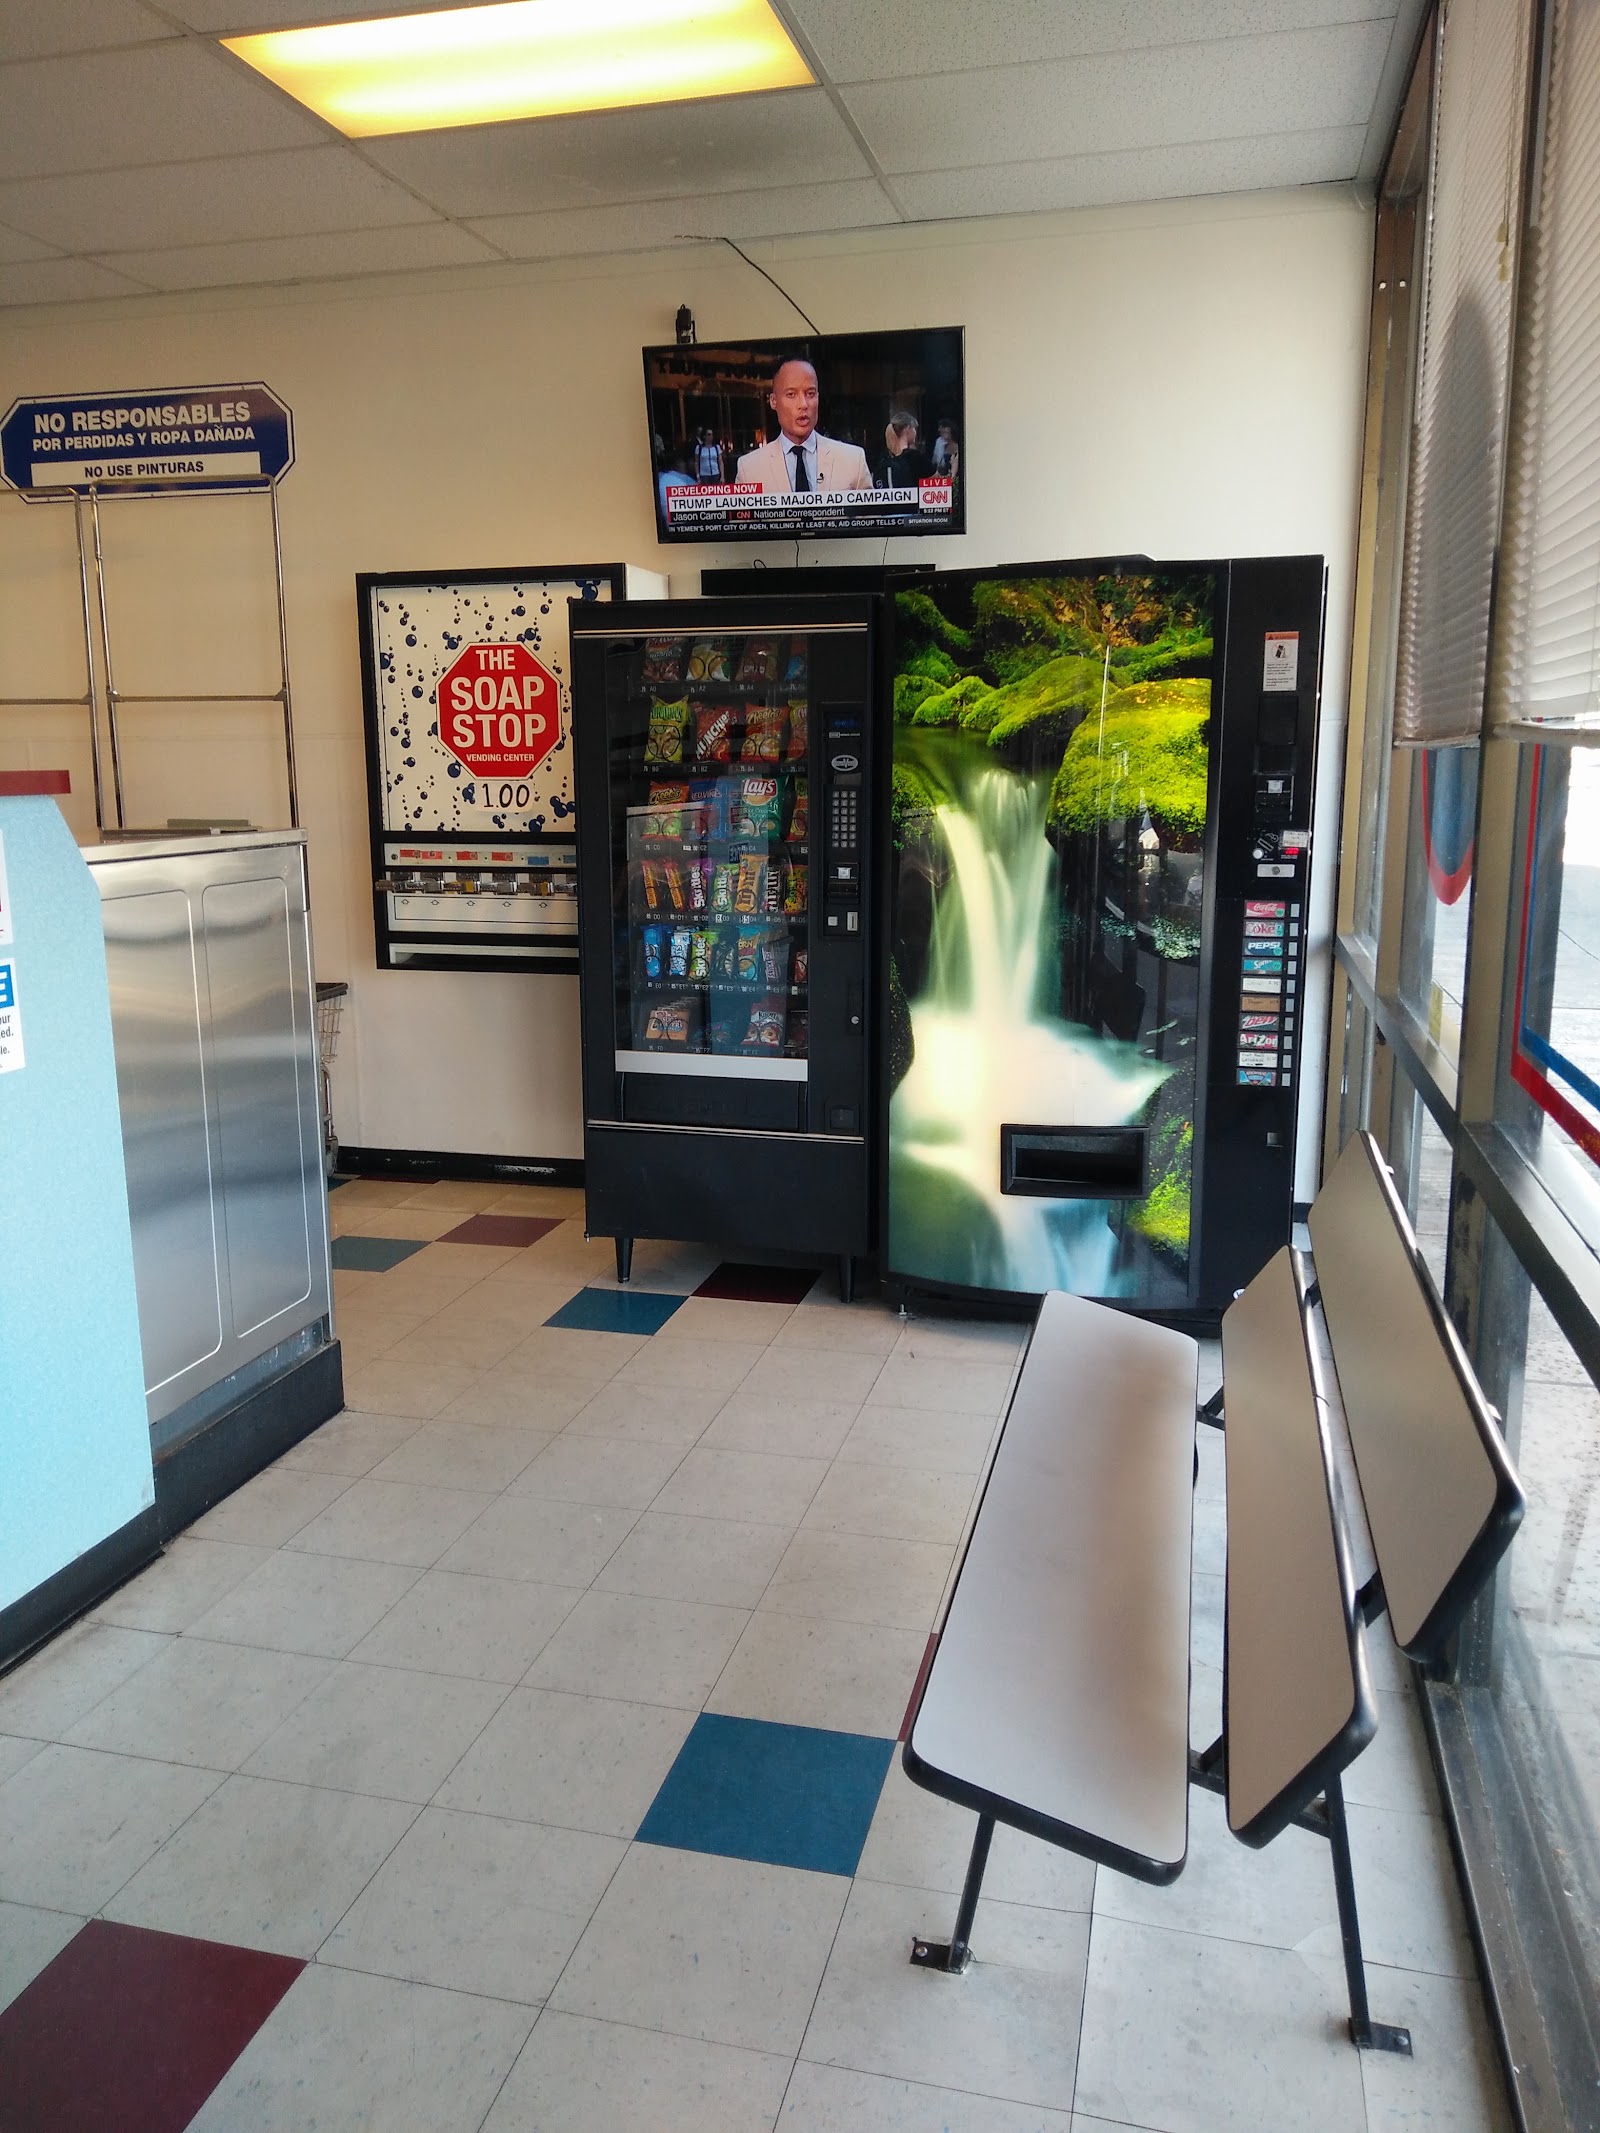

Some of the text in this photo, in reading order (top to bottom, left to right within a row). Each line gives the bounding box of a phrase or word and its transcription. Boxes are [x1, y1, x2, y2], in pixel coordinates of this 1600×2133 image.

[34, 402, 250, 433] NO RESPONSABLES
[32, 424, 255, 451] POR PERDIDAS Y ROPA DAÑADA
[84, 461, 204, 477] NO USE PINTURAS
[671, 484, 758, 496] DEVELOPING NOW
[923, 479, 948, 487] LIVE
[672, 491, 912, 510] TRUMP LAUNCHES MAJOR AD CAMPAIGN
[922, 490, 948, 504] CNN
[673, 507, 845, 522] Jason Carroll CNN National Correspondent
[676, 525, 704, 533] YEMEN'S
[705, 524, 722, 532] PORT
[749, 523, 769, 531] ADEN,
[769, 522, 795, 530] KILLING
[805, 520, 827, 528] LEAST
[838, 519, 850, 527] AID
[851, 519, 875, 527] GROUP
[875, 518, 896, 526] TELLS
[475, 648, 516, 671] THE
[450, 675, 545, 712] SOAP
[452, 712, 547, 748] STOP
[466, 753, 534, 762] VENDING CENTER
[482, 783, 530, 808] 1.00
[743, 779, 776, 796] Lay's
[1248, 941, 1281, 950] PEPSI
